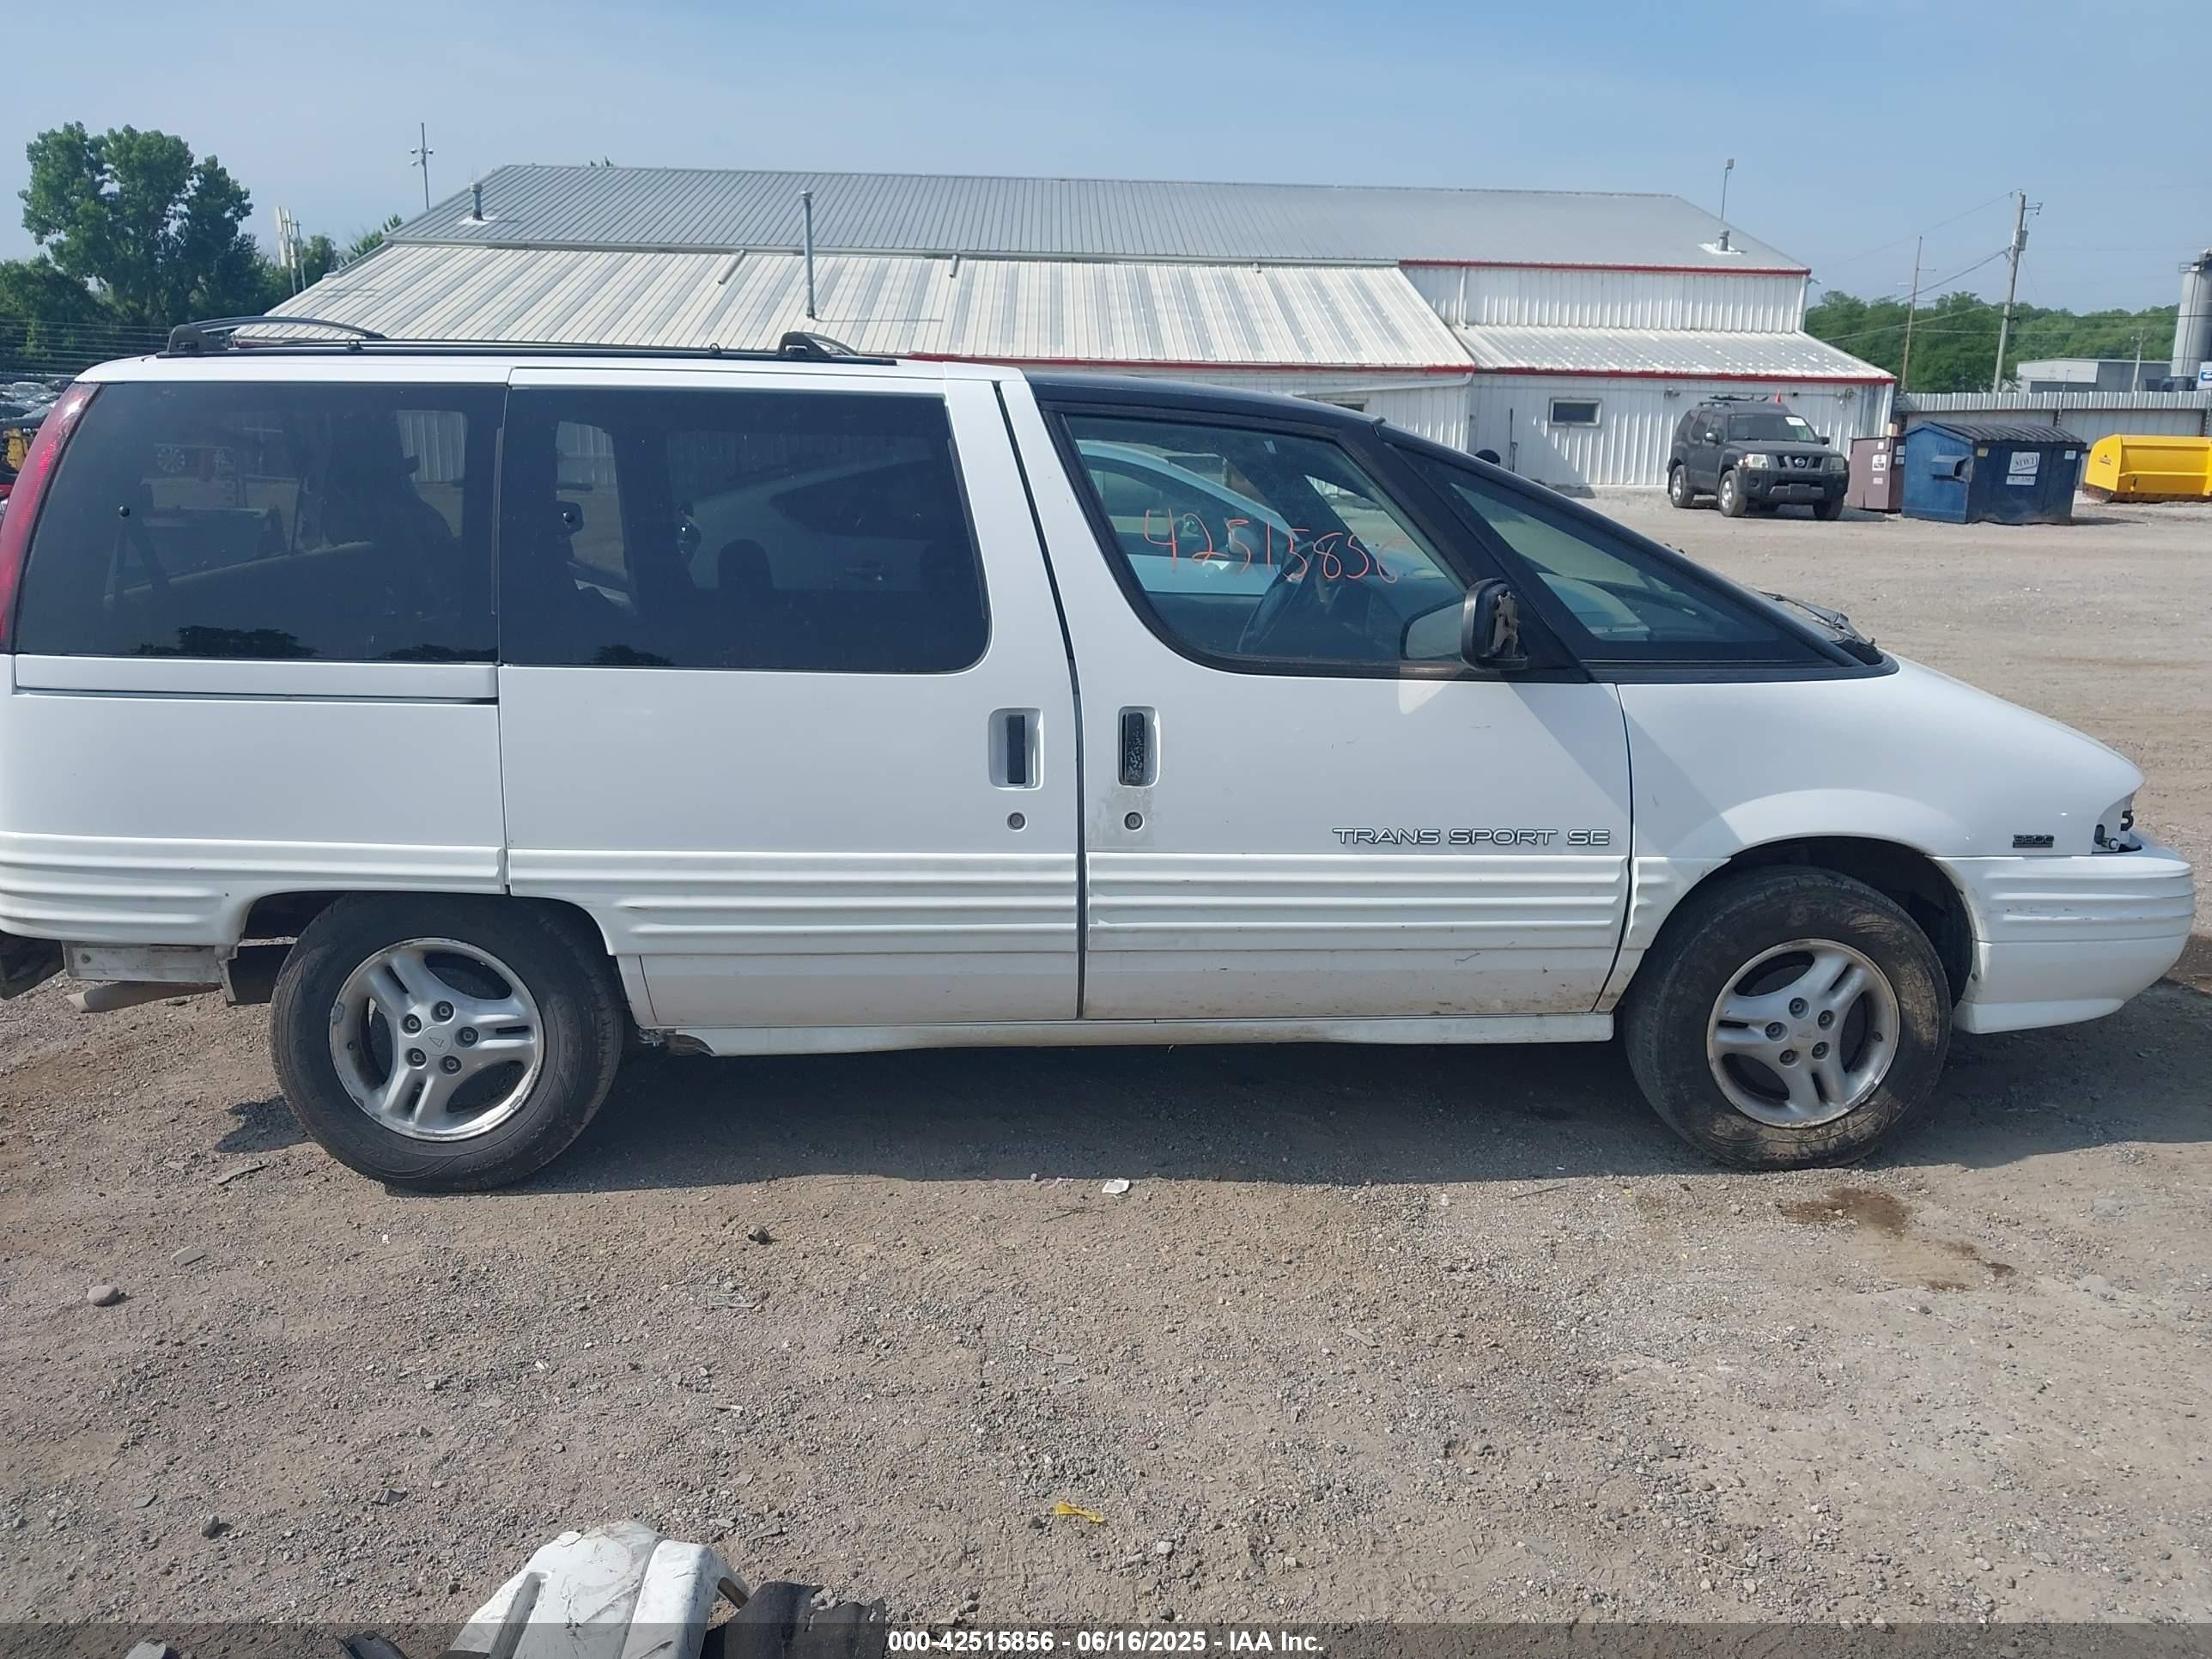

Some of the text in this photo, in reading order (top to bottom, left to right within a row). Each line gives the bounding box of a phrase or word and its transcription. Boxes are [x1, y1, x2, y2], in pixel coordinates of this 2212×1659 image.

[1144, 508, 1407, 585] 42515856
[1332, 827, 1611, 847] TRANS SPORT SE
